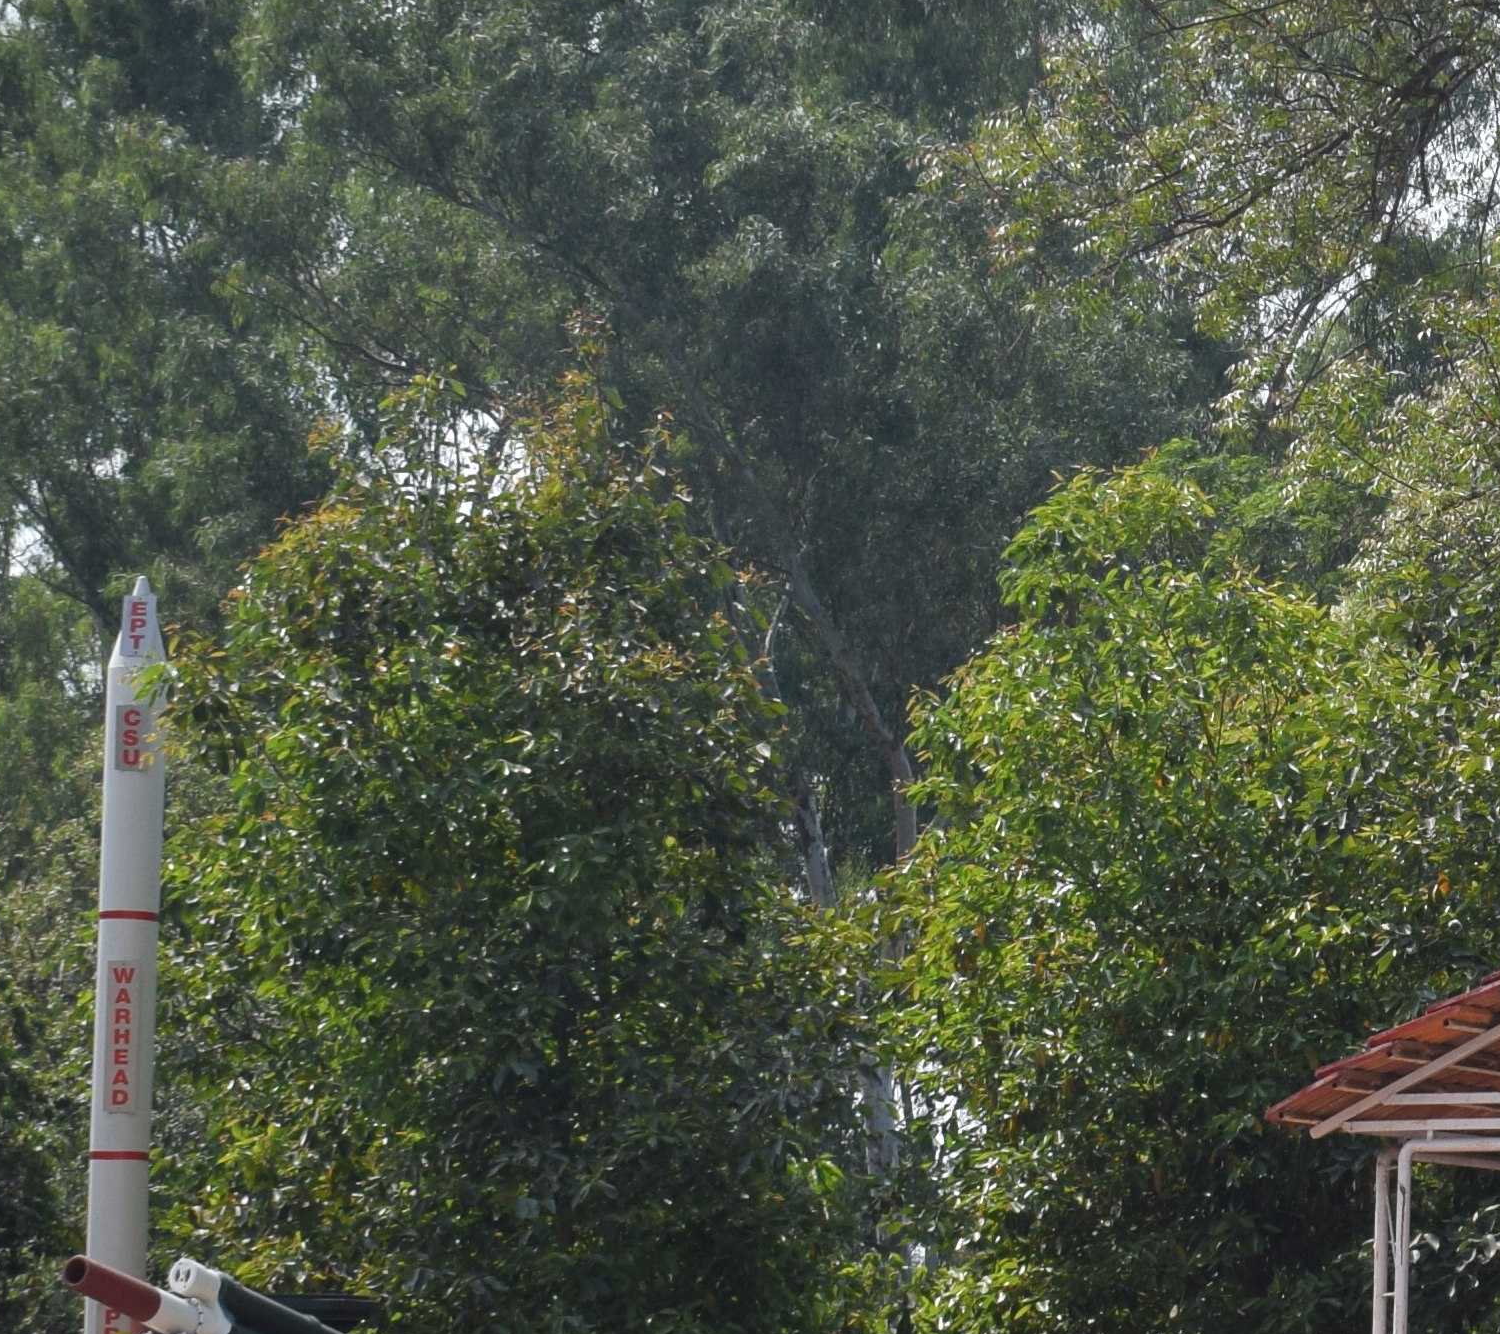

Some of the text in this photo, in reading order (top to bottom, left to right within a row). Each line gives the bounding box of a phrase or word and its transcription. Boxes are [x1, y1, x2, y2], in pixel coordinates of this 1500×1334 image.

[129, 602, 148, 650] EPT
[122, 710, 141, 765] CSU
[111, 968, 135, 1105] WARHEAD
